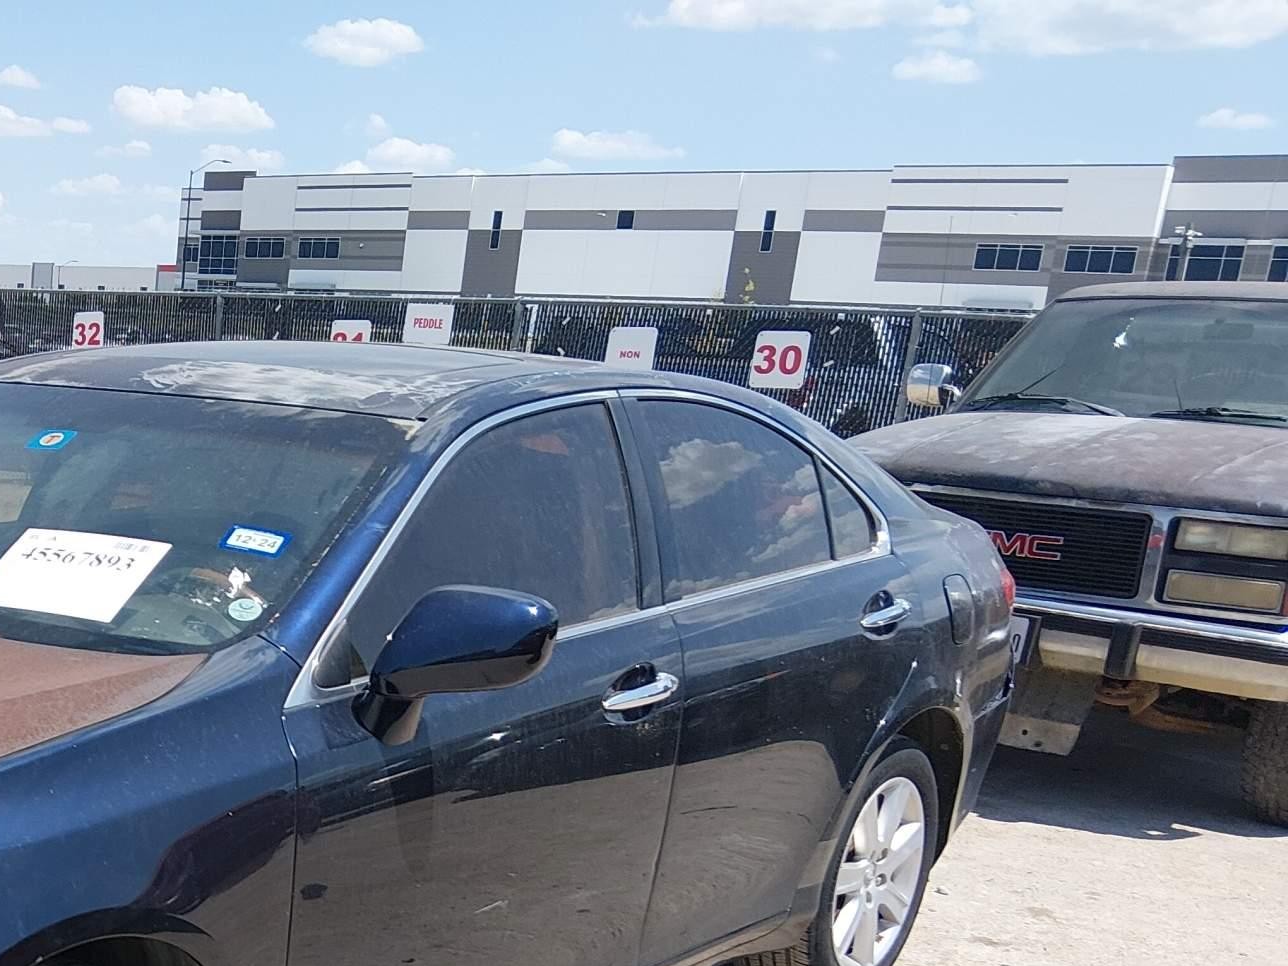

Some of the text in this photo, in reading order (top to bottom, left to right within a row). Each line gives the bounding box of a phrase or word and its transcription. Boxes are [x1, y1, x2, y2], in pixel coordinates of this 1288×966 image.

[74, 322, 101, 346] 32
[413, 317, 444, 329] PEDDLE
[619, 350, 641, 359] NON
[753, 344, 803, 375] 30
[985, 529, 1065, 560] MC
[21, 546, 136, 571] 45567893
